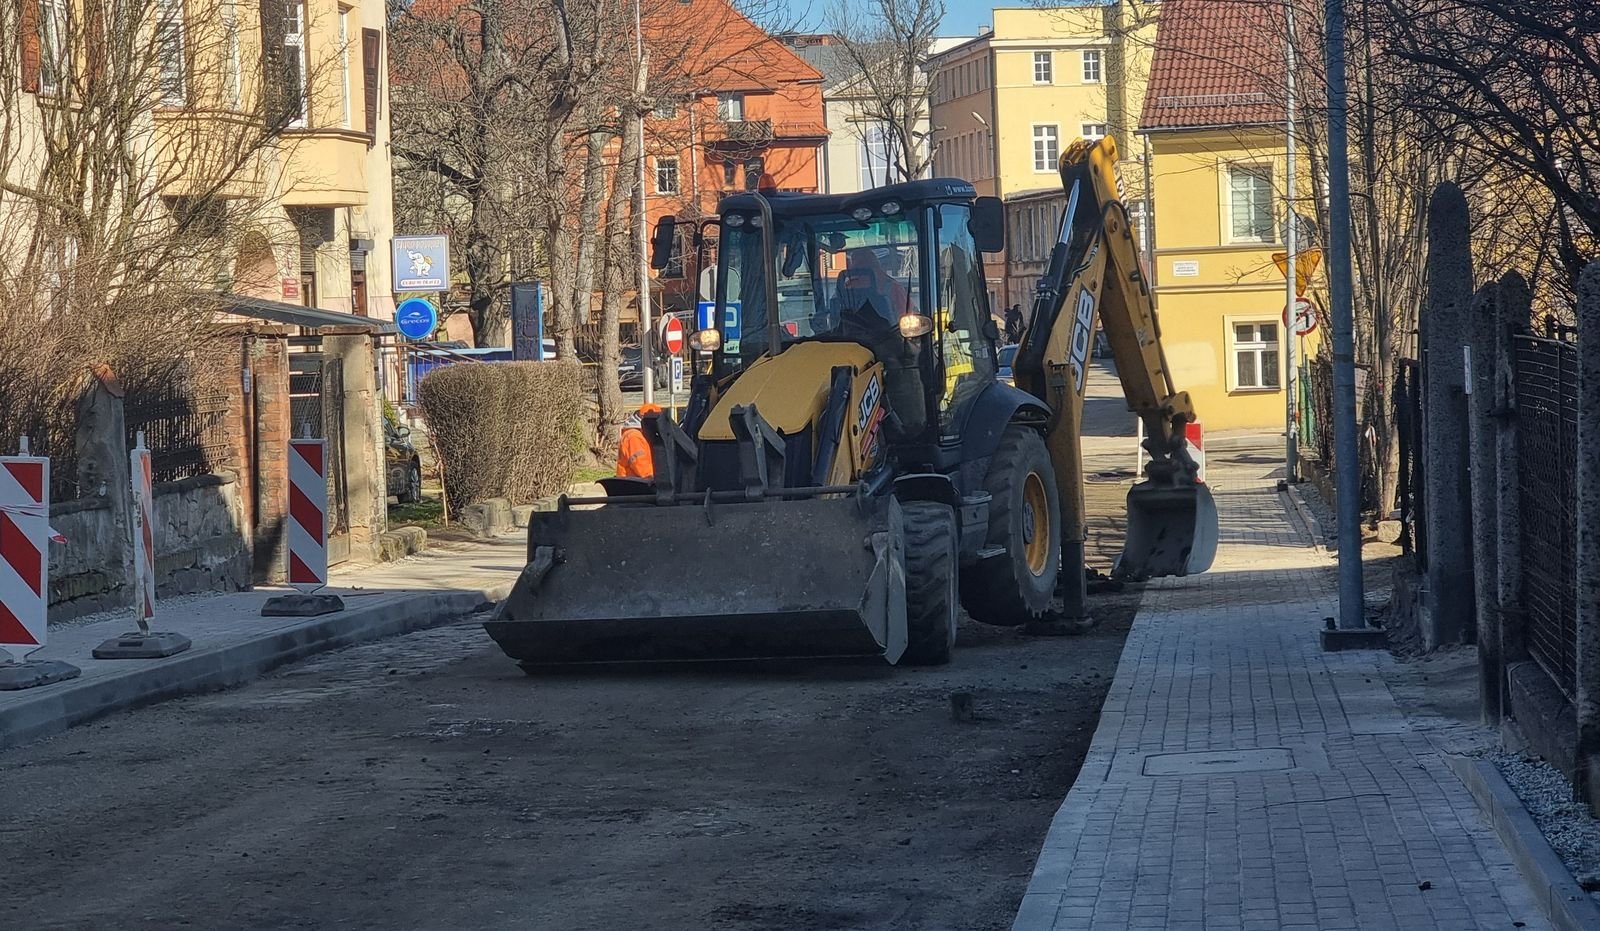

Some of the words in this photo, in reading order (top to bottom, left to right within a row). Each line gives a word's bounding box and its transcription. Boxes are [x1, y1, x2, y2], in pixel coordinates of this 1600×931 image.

[707, 306, 738, 329] P
[1070, 289, 1094, 391] JCB
[860, 375, 880, 429] JCB
